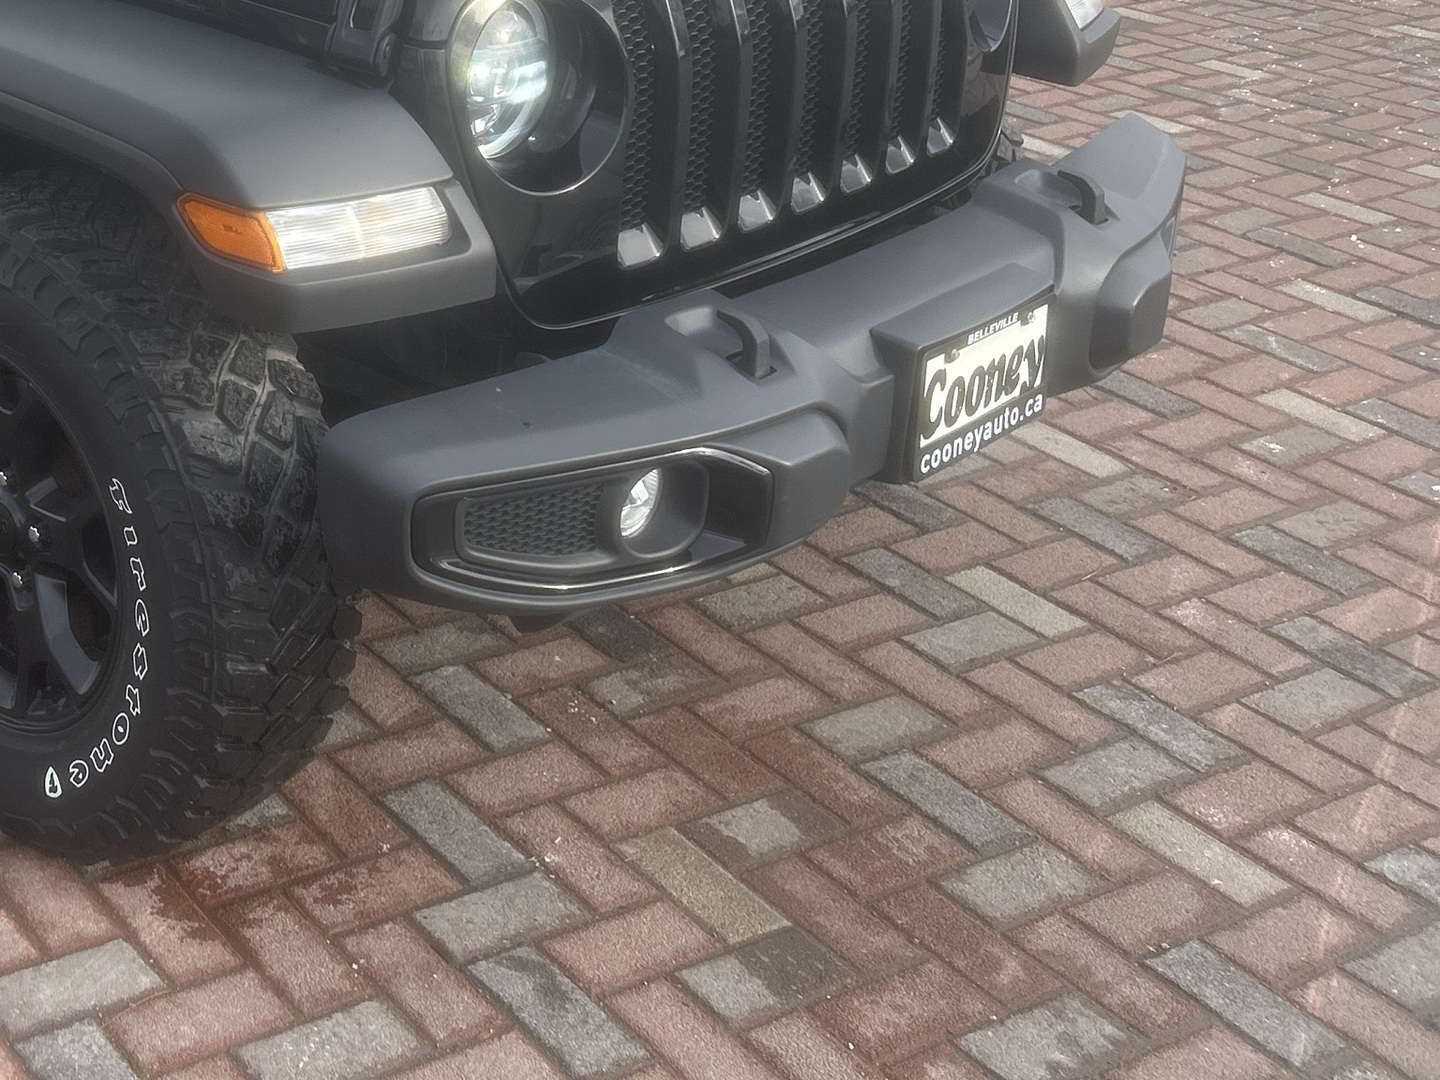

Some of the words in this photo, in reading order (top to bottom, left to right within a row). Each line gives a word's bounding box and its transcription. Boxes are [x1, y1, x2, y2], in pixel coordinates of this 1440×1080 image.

[967, 312, 1020, 346] BELLEVILLE
[920, 334, 1047, 441] Cooney
[920, 392, 1043, 474] cooneyauto.ca
